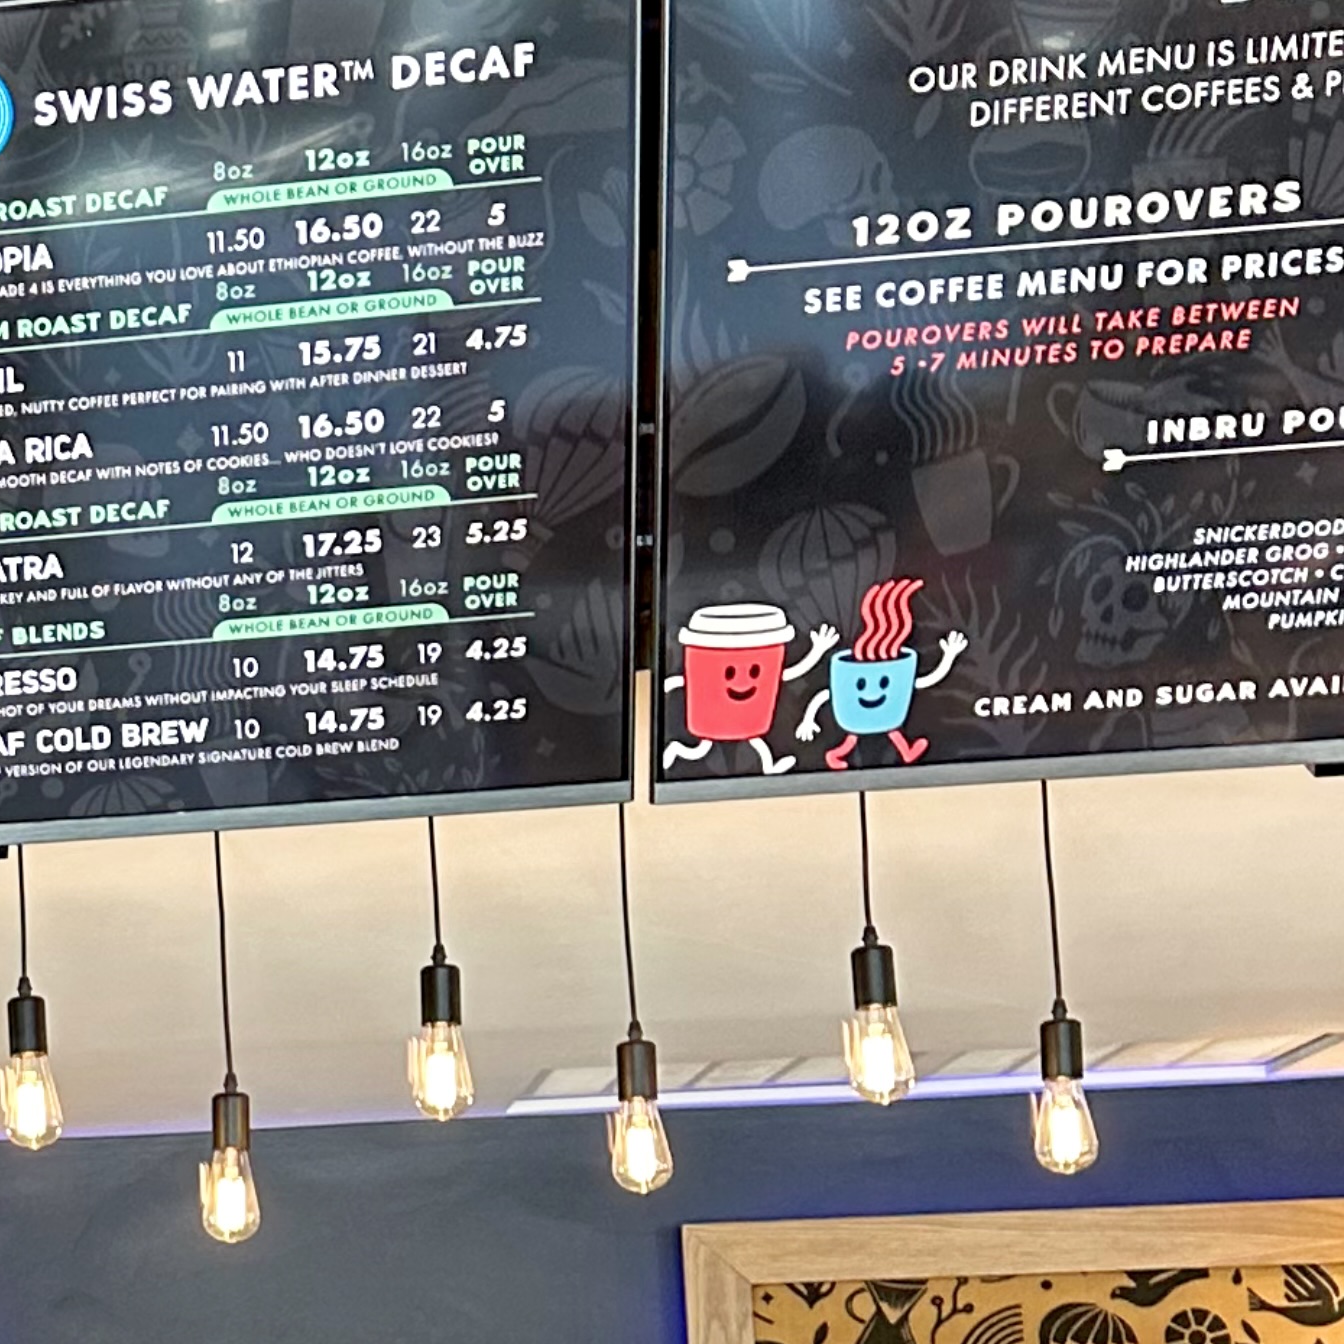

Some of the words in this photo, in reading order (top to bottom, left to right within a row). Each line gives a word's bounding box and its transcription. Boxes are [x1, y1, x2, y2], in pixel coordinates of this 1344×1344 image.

[34, 80, 172, 126] SWISS
[392, 42, 534, 90] DECAF
[909, 63, 977, 93] OUR
[989, 53, 1086, 87] DRINK
[1098, 44, 1195, 77] MENU
[1207, 40, 1234, 67] IS
[971, 88, 1132, 127] DIFFERENT
[1141, 75, 1280, 112] COFFEES
[1291, 73, 1314, 100] &
[86, 186, 168, 213] DECAF
[852, 208, 971, 247] 12OZ
[997, 181, 1301, 236] POUROVERS
[804, 285, 861, 314] SEE
[875, 274, 1003, 308] COFFEE
[1017, 264, 1123, 297] MENU
[1137, 258, 1207, 288] FOR
[1221, 246, 1344, 281] PRICES
[17, 312, 101, 338] ROAST
[110, 303, 192, 329] DECAF
[846, 319, 1008, 351] POUROVERS
[1022, 314, 1081, 336] WILL
[1095, 307, 1160, 332] TAKE
[1172, 297, 1299, 325] BETWEEN
[956, 342, 1076, 370] MINUTES
[1091, 339, 1124, 360] TO
[1136, 329, 1251, 356] PREPARE
[1147, 412, 1264, 444] INBRU
[25, 433, 93, 464] RICA
[0, 507, 82, 532] ROAST
[90, 499, 170, 524] DECAF
[1125, 547, 1259, 572] HIGHLANDER
[1265, 542, 1329, 562] GROG
[12, 621, 105, 645] BLENDS
[974, 692, 1071, 717] CREAM
[1083, 688, 1143, 710] AND
[1156, 681, 1256, 705] SUGAR
[36, 725, 111, 753] COLD
[122, 718, 209, 747] BREW
